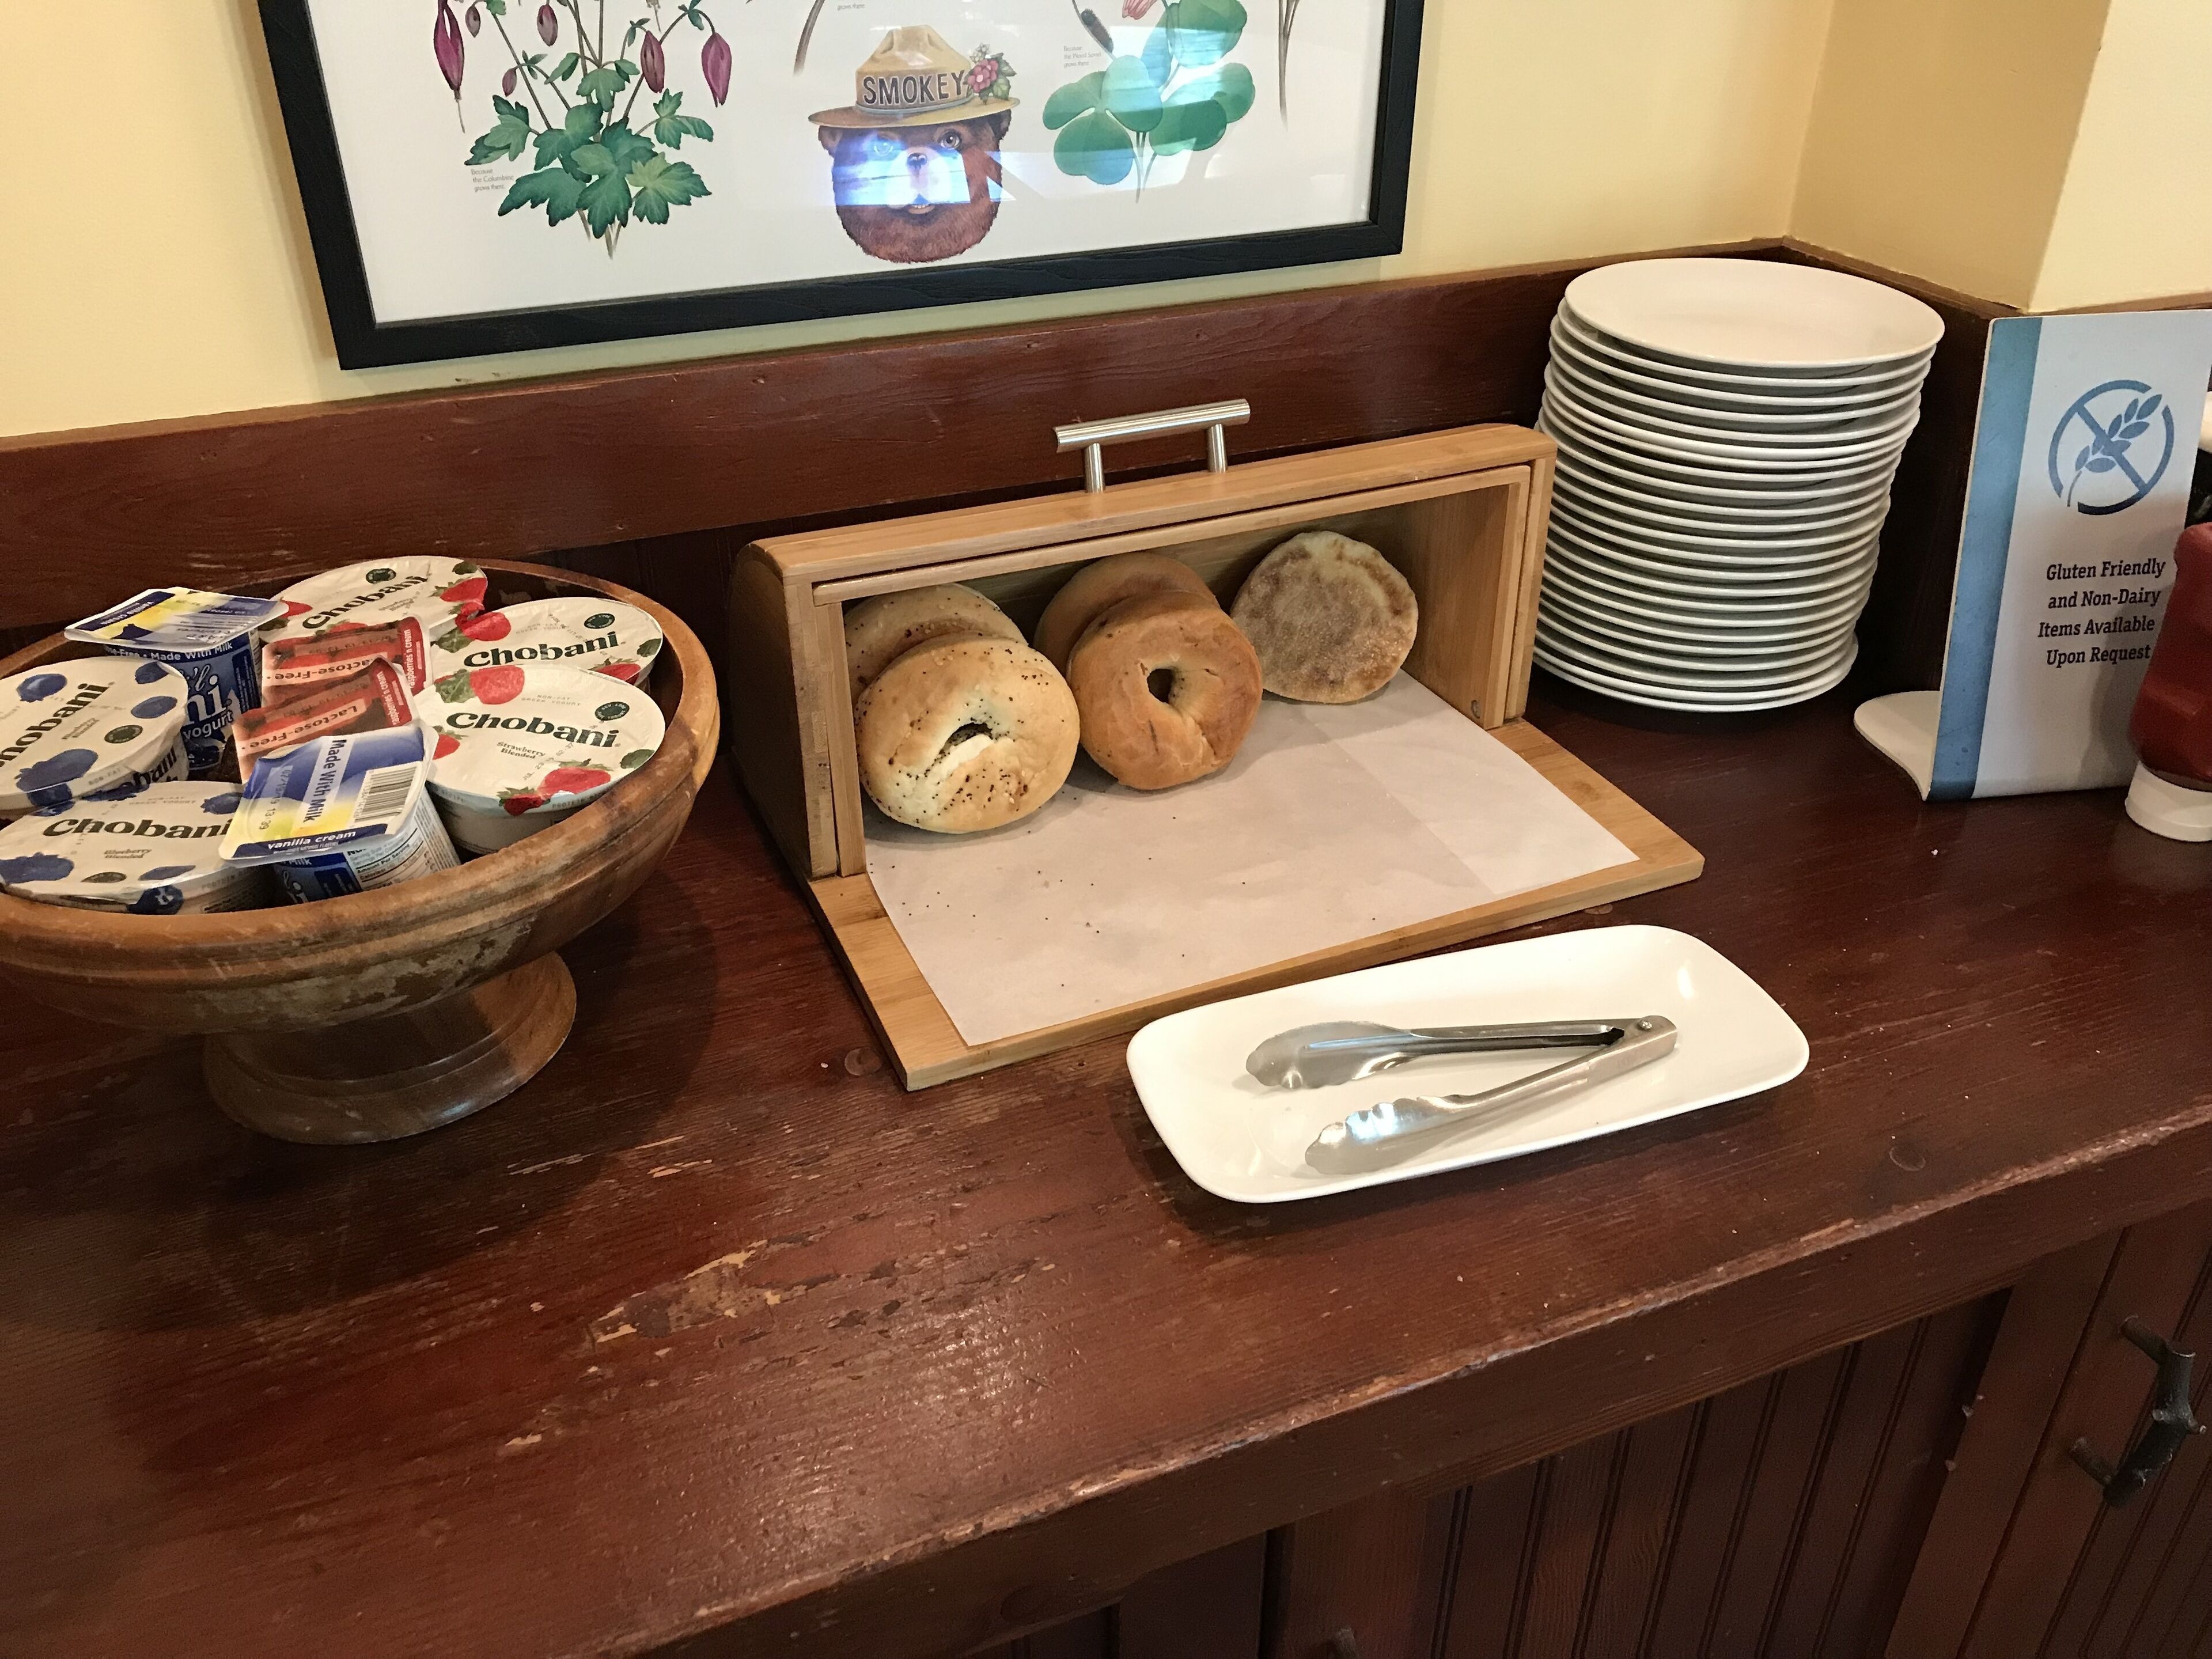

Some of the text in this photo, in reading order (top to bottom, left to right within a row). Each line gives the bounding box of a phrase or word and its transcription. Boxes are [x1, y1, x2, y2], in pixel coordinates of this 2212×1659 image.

[863, 70, 965, 104] SMOKEY
[2046, 558, 2166, 581] Gluten Friendly
[302, 575, 428, 629] Chobani
[2048, 587, 2161, 609] and Non-Dairy
[404, 628, 412, 647] cream
[2037, 615, 2156, 638] Items Available
[150, 652, 181, 661] Made
[184, 649, 212, 661] With
[213, 642, 233, 654] Milk
[463, 631, 619, 667] Chobani
[2047, 645, 2151, 668] Upon Request
[275, 658, 374, 680] actose-Free
[377, 671, 389, 690] cream
[0, 683, 109, 767] hobani
[183, 711, 233, 740] yogurt
[249, 704, 358, 748] Lactose-Free
[446, 712, 619, 748] Chobani
[497, 741, 546, 757] Strawberry
[501, 748, 536, 759] Blended
[303, 739, 347, 823] Made With Milk
[43, 818, 233, 839] Chobani
[268, 831, 357, 850] vanilla cream
